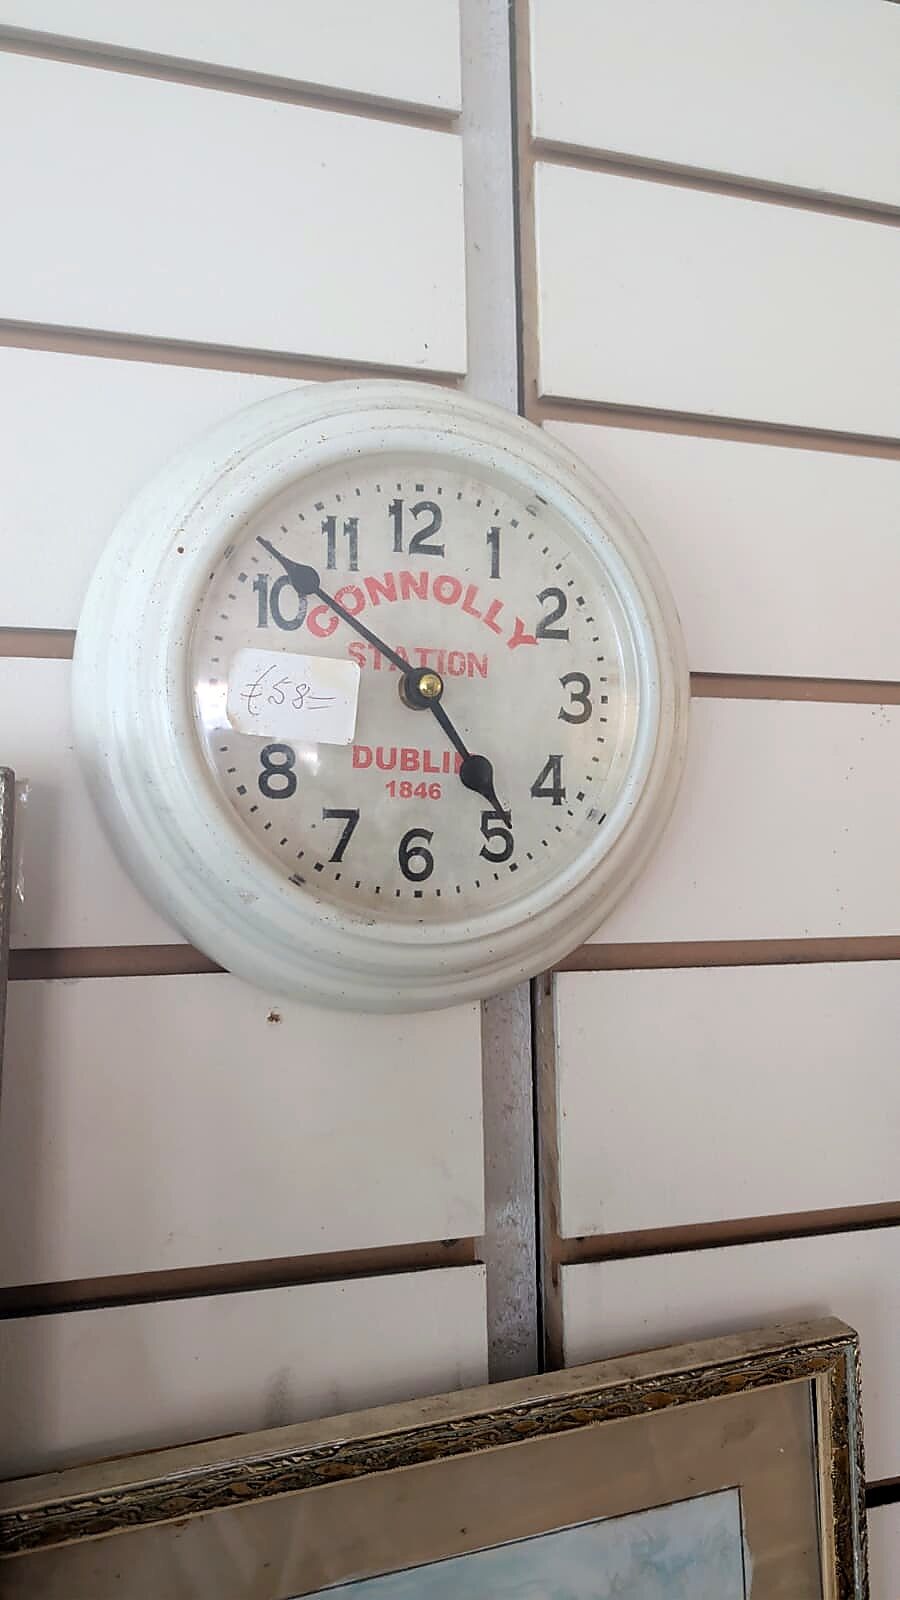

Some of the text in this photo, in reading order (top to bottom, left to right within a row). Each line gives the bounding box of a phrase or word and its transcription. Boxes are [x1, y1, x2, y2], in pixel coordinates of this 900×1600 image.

[321, 515, 361, 572] 11
[388, 499, 446, 558] 12
[486, 526, 502, 579] 1
[252, 573, 308, 632] 10
[306, 570, 539, 651] CONNOLLY
[536, 587, 570, 641] 2
[558, 671, 594, 725] 3
[257, 743, 298, 800] 8
[385, 780, 442, 801] 1846
[530, 754, 567, 806] 4
[321, 808, 361, 863] 7
[398, 828, 435, 883] 6
[479, 809, 515, 863] 5
